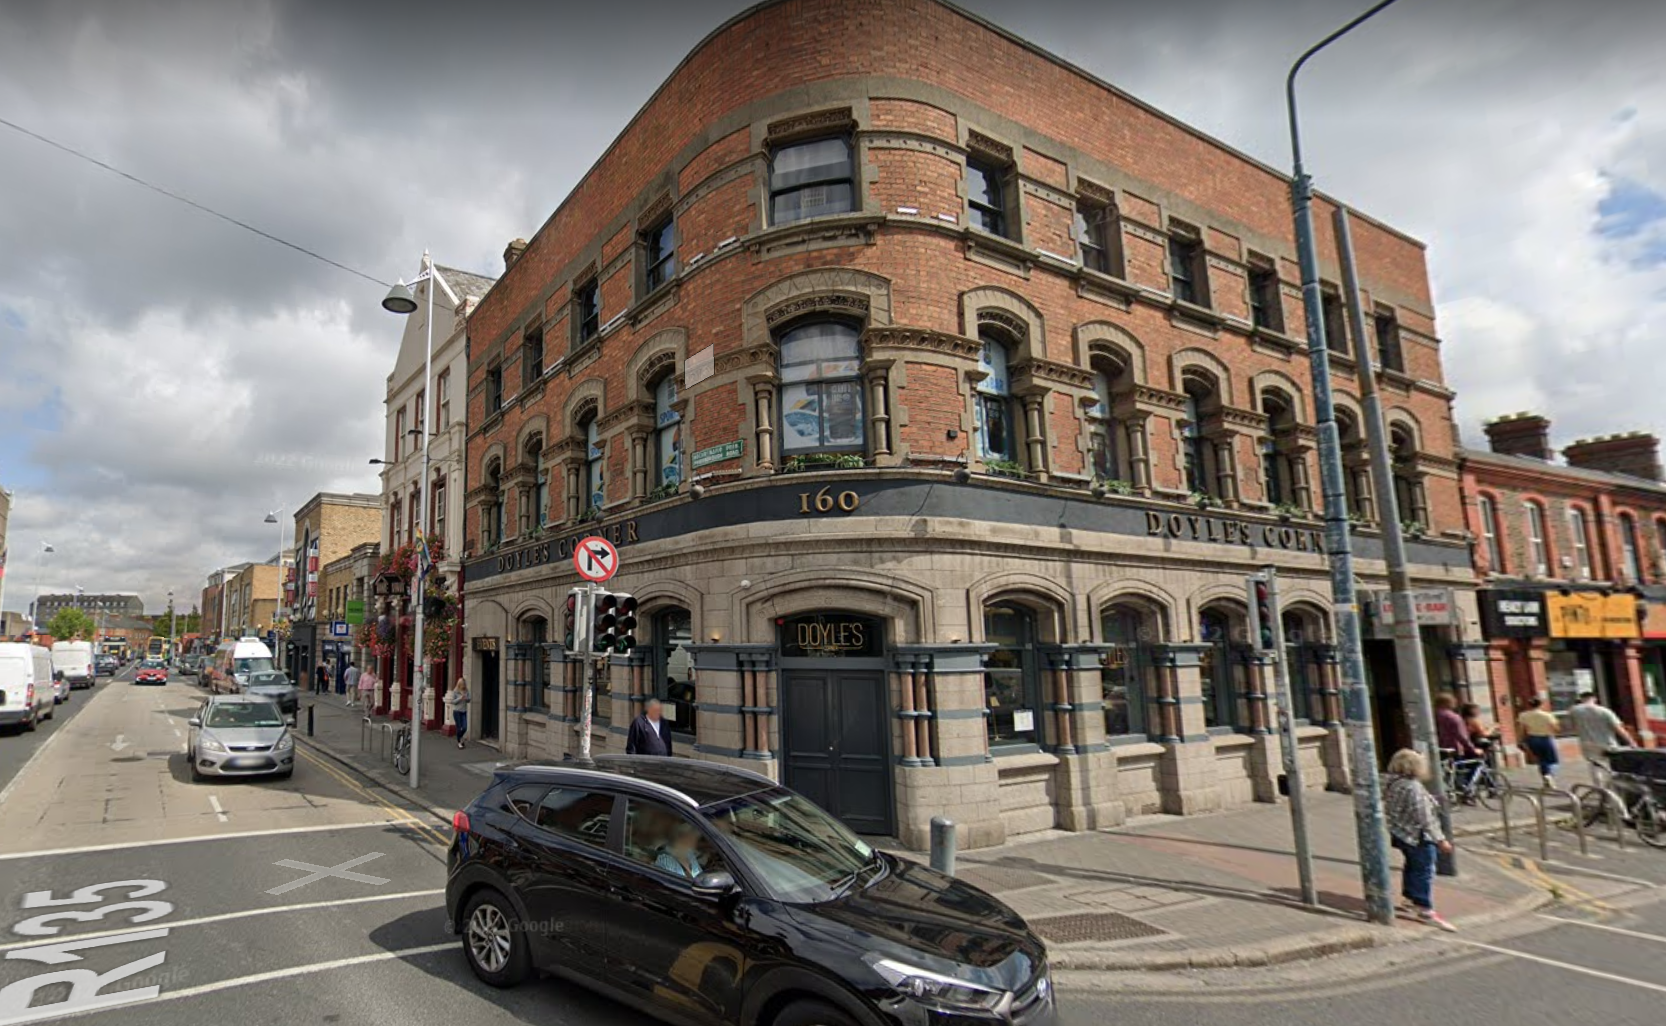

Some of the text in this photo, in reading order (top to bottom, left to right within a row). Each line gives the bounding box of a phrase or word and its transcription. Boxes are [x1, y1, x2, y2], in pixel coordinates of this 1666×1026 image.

[799, 485, 860, 514] 160
[1145, 511, 1326, 552] DOYLE'S CORN
[497, 543, 549, 572] DOYLE'S
[798, 622, 864, 646] DOYLE'S
